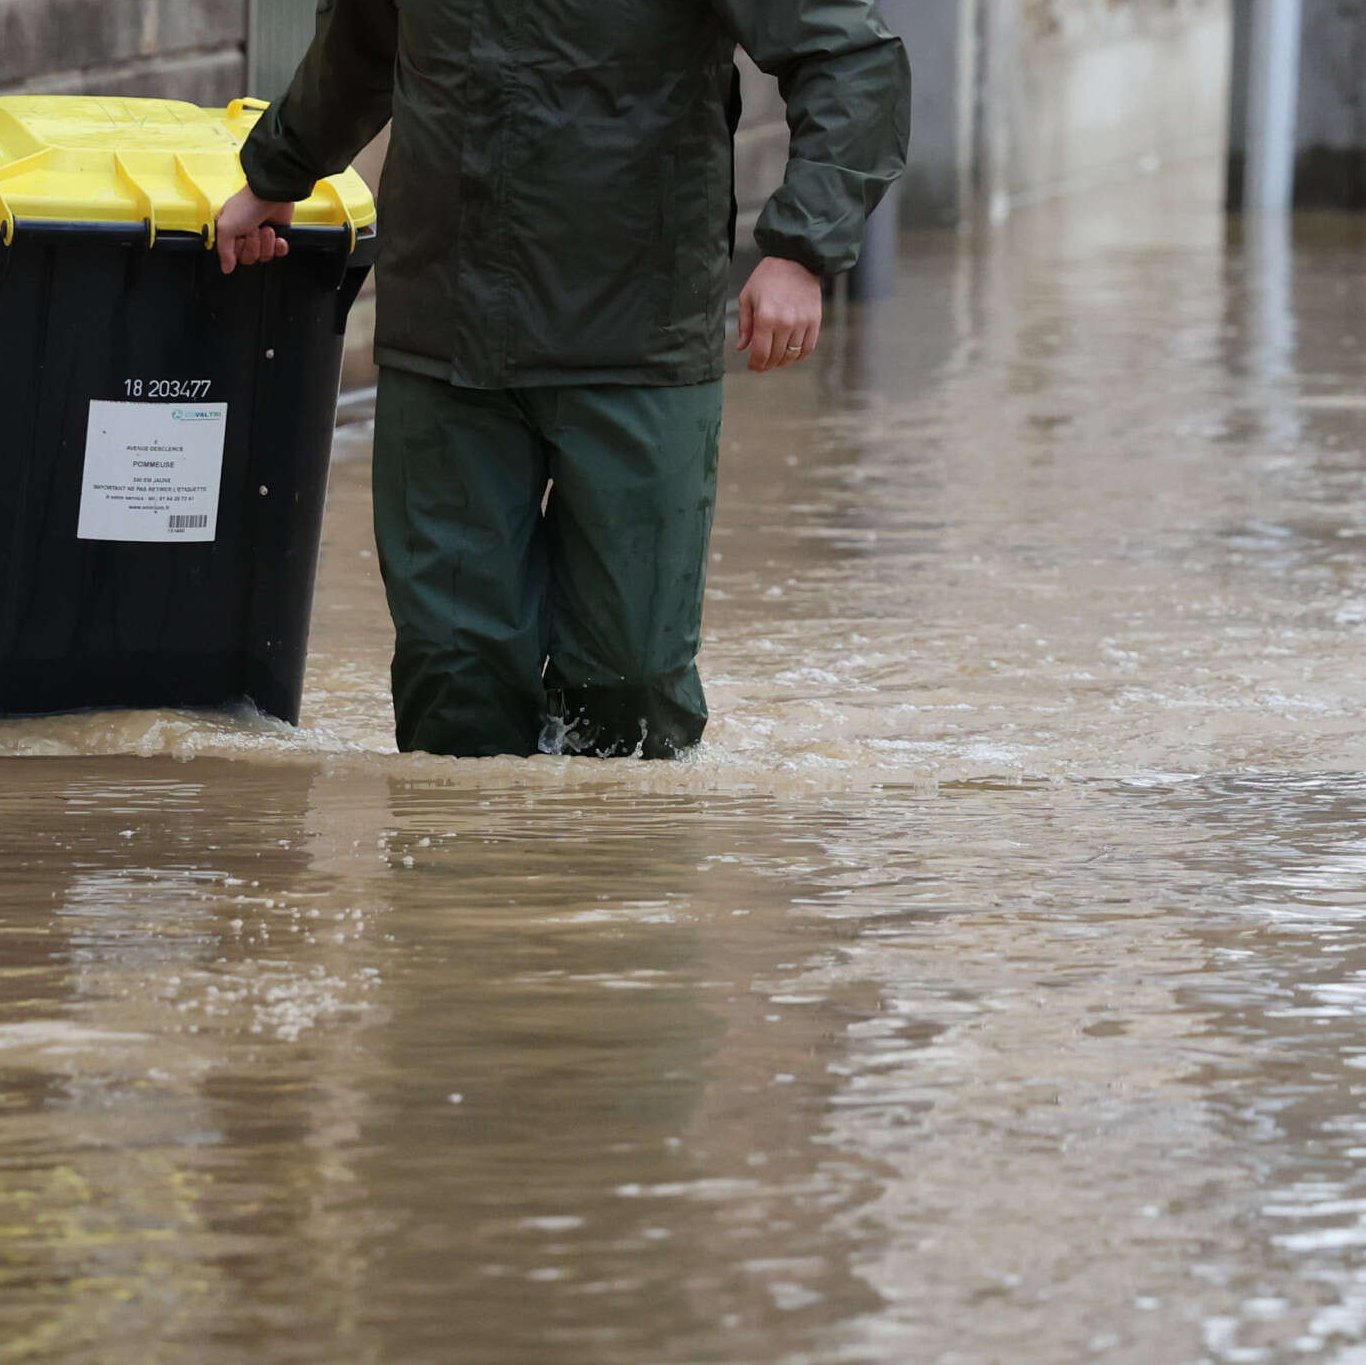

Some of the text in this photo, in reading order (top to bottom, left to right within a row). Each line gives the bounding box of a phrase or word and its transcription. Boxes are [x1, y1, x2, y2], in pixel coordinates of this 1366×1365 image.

[124, 378, 212, 398] 18 203477
[132, 460, 175, 469] POMMEUSE
